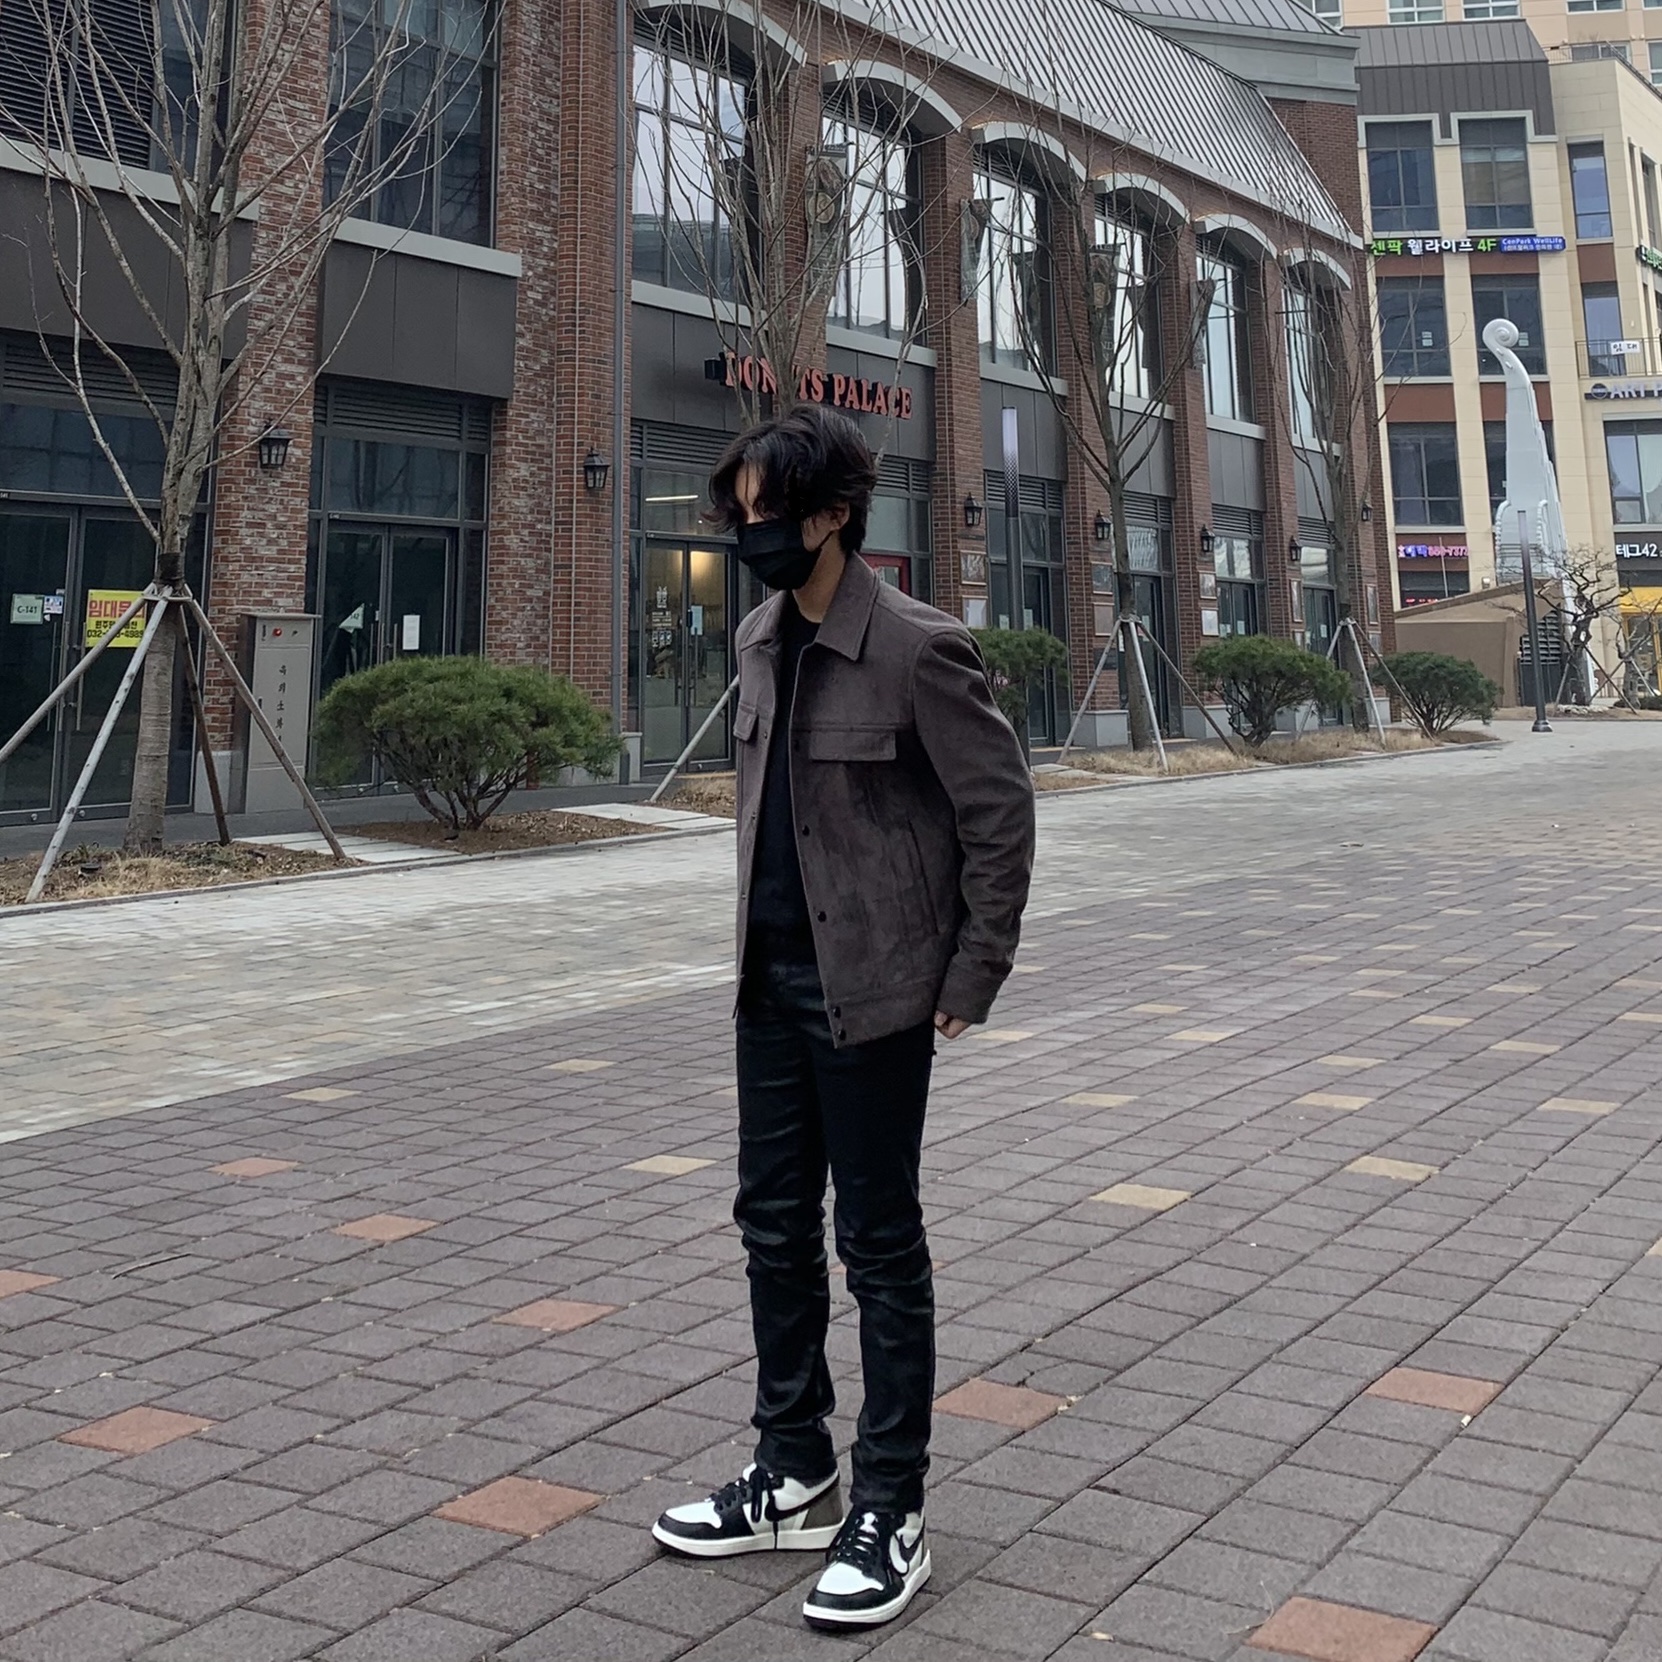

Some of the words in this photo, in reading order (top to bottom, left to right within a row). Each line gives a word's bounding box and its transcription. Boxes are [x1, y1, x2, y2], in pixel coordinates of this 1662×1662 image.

[1370, 239, 1402, 256] 센팍
[1476, 237, 1497, 253] 4F
[725, 351, 824, 403] DONTS
[832, 373, 913, 420] PALACE
[16, 605, 38, 614] C-141
